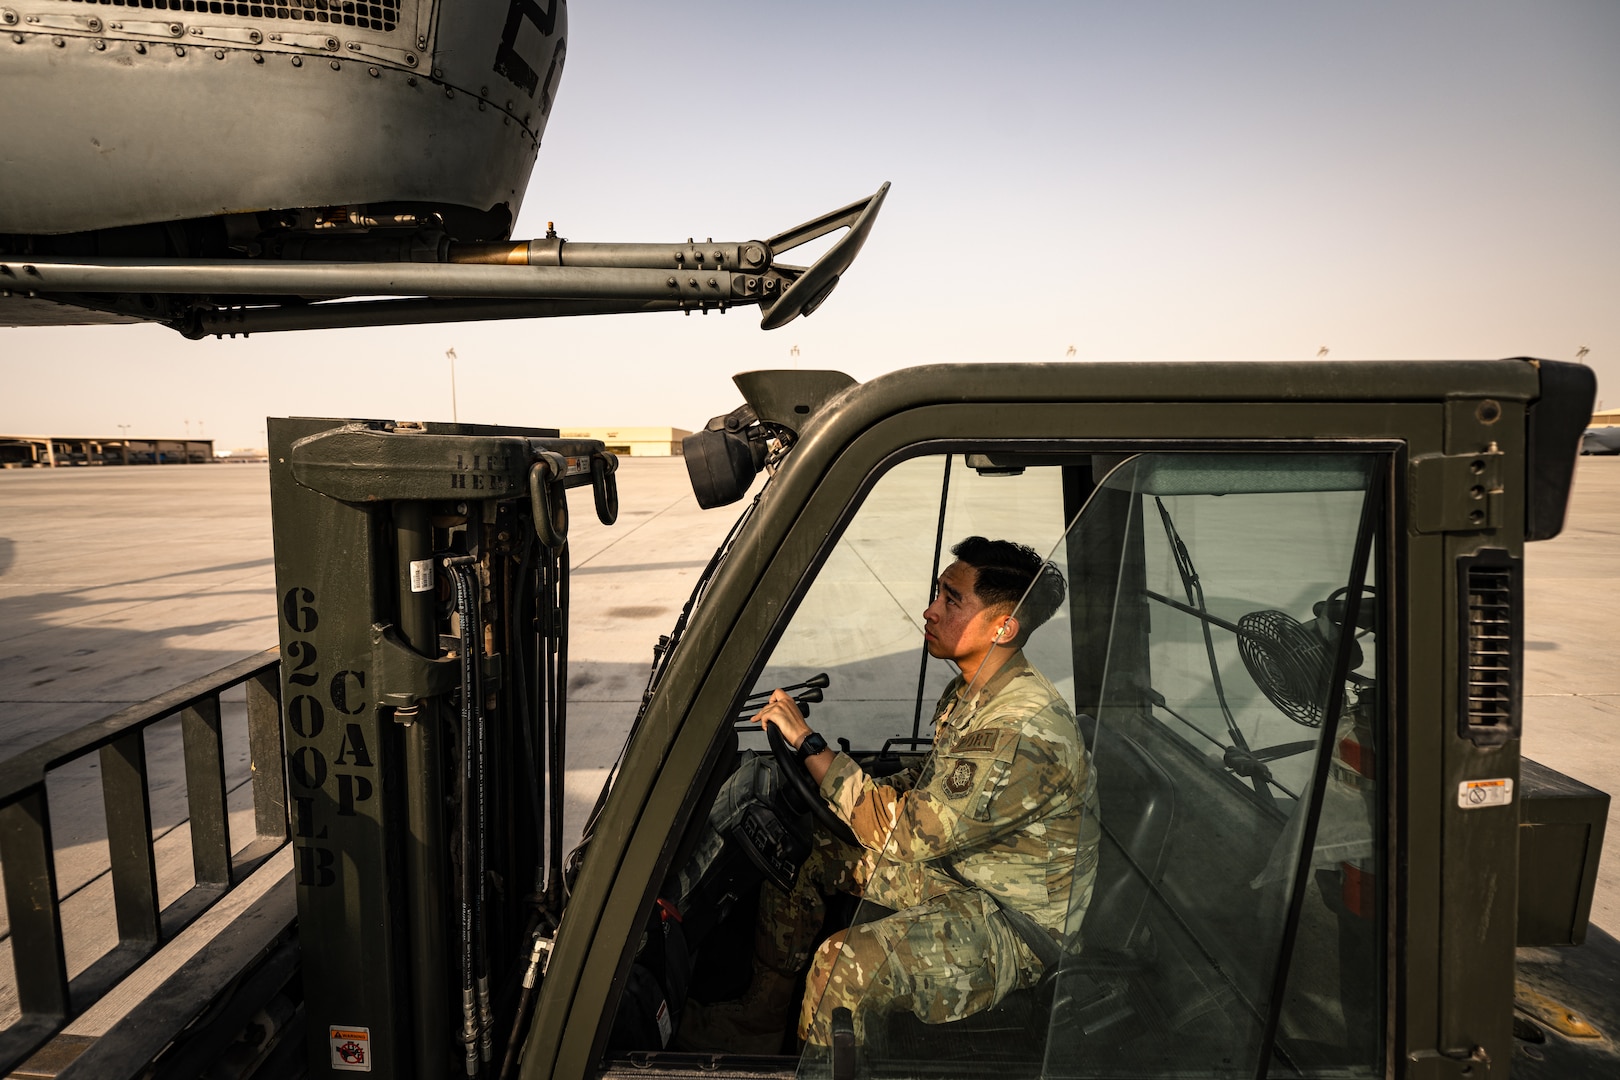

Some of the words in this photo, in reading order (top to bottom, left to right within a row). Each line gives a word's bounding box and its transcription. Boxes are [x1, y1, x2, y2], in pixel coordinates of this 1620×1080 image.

[457, 454, 512, 471] LIFT
[451, 474, 516, 490] HER
[330, 669, 374, 817] CAP
